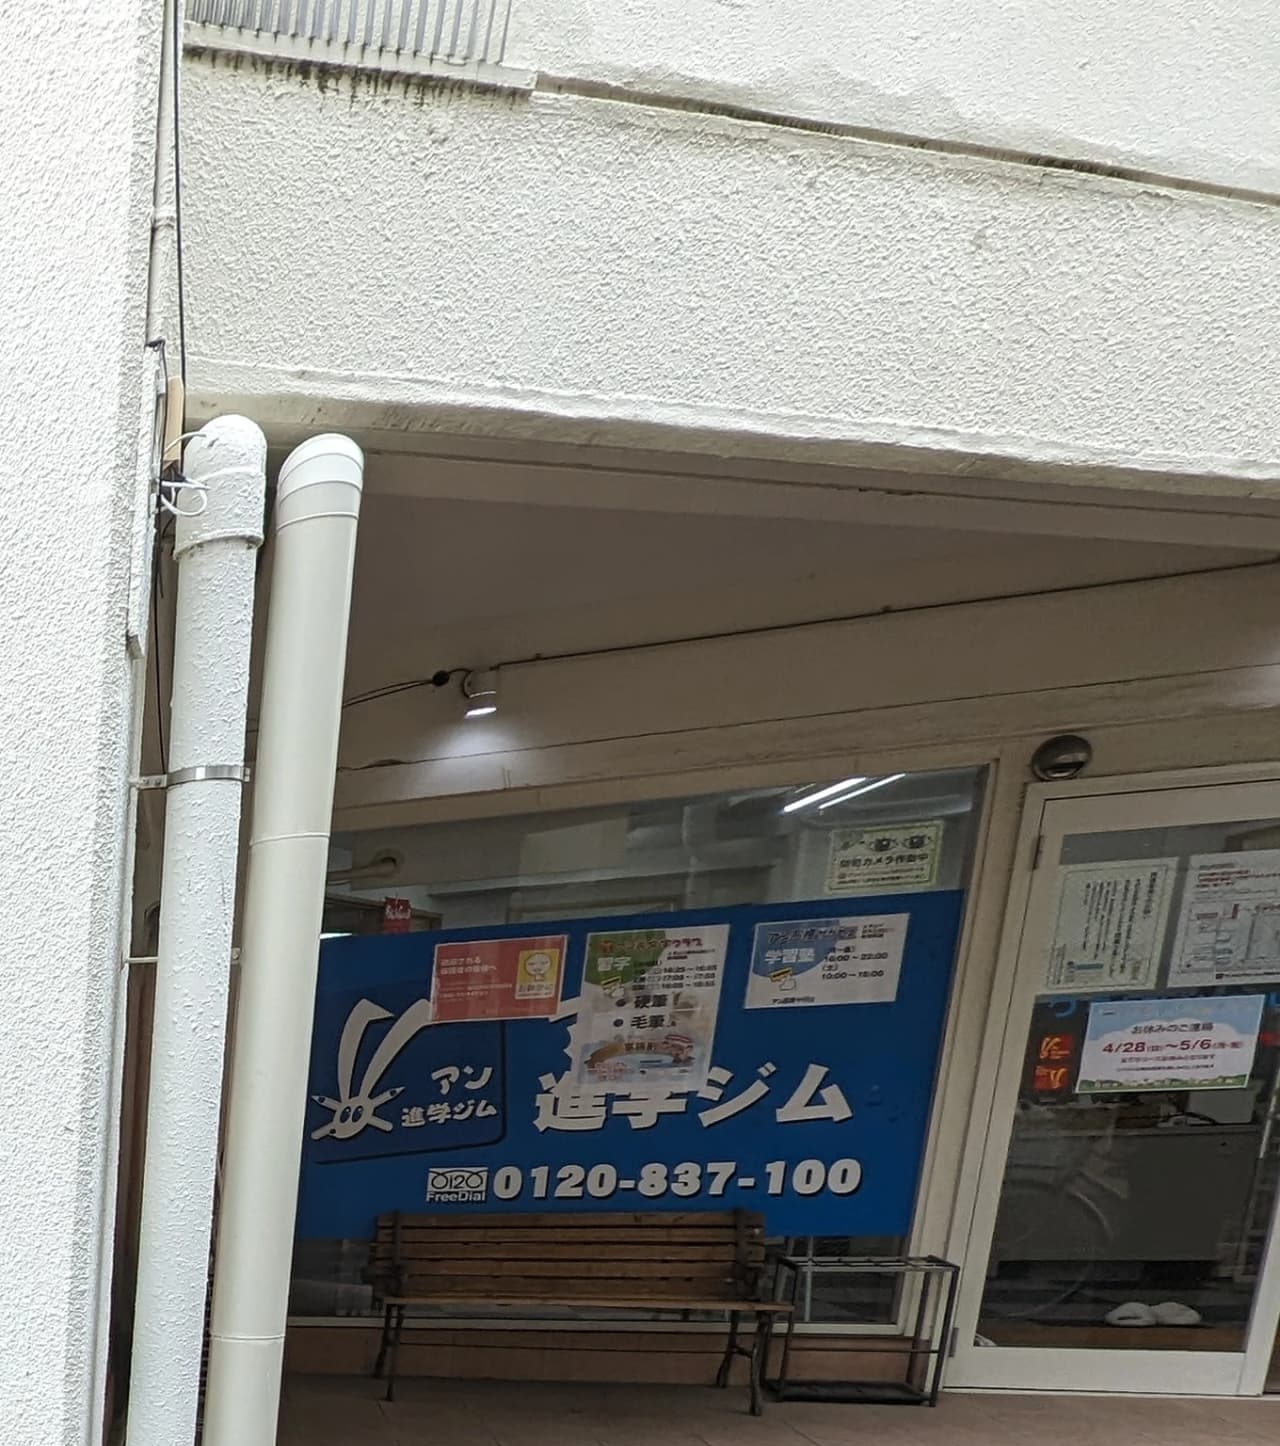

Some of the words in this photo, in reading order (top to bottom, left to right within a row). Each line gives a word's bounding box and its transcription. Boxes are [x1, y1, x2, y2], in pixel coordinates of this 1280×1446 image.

[431, 1065, 493, 1095] アン
[401, 1099, 498, 1127] 進学ジム
[493, 1158, 862, 1199] 0120-837-100
[426, 1191, 486, 1202] FreeDial
